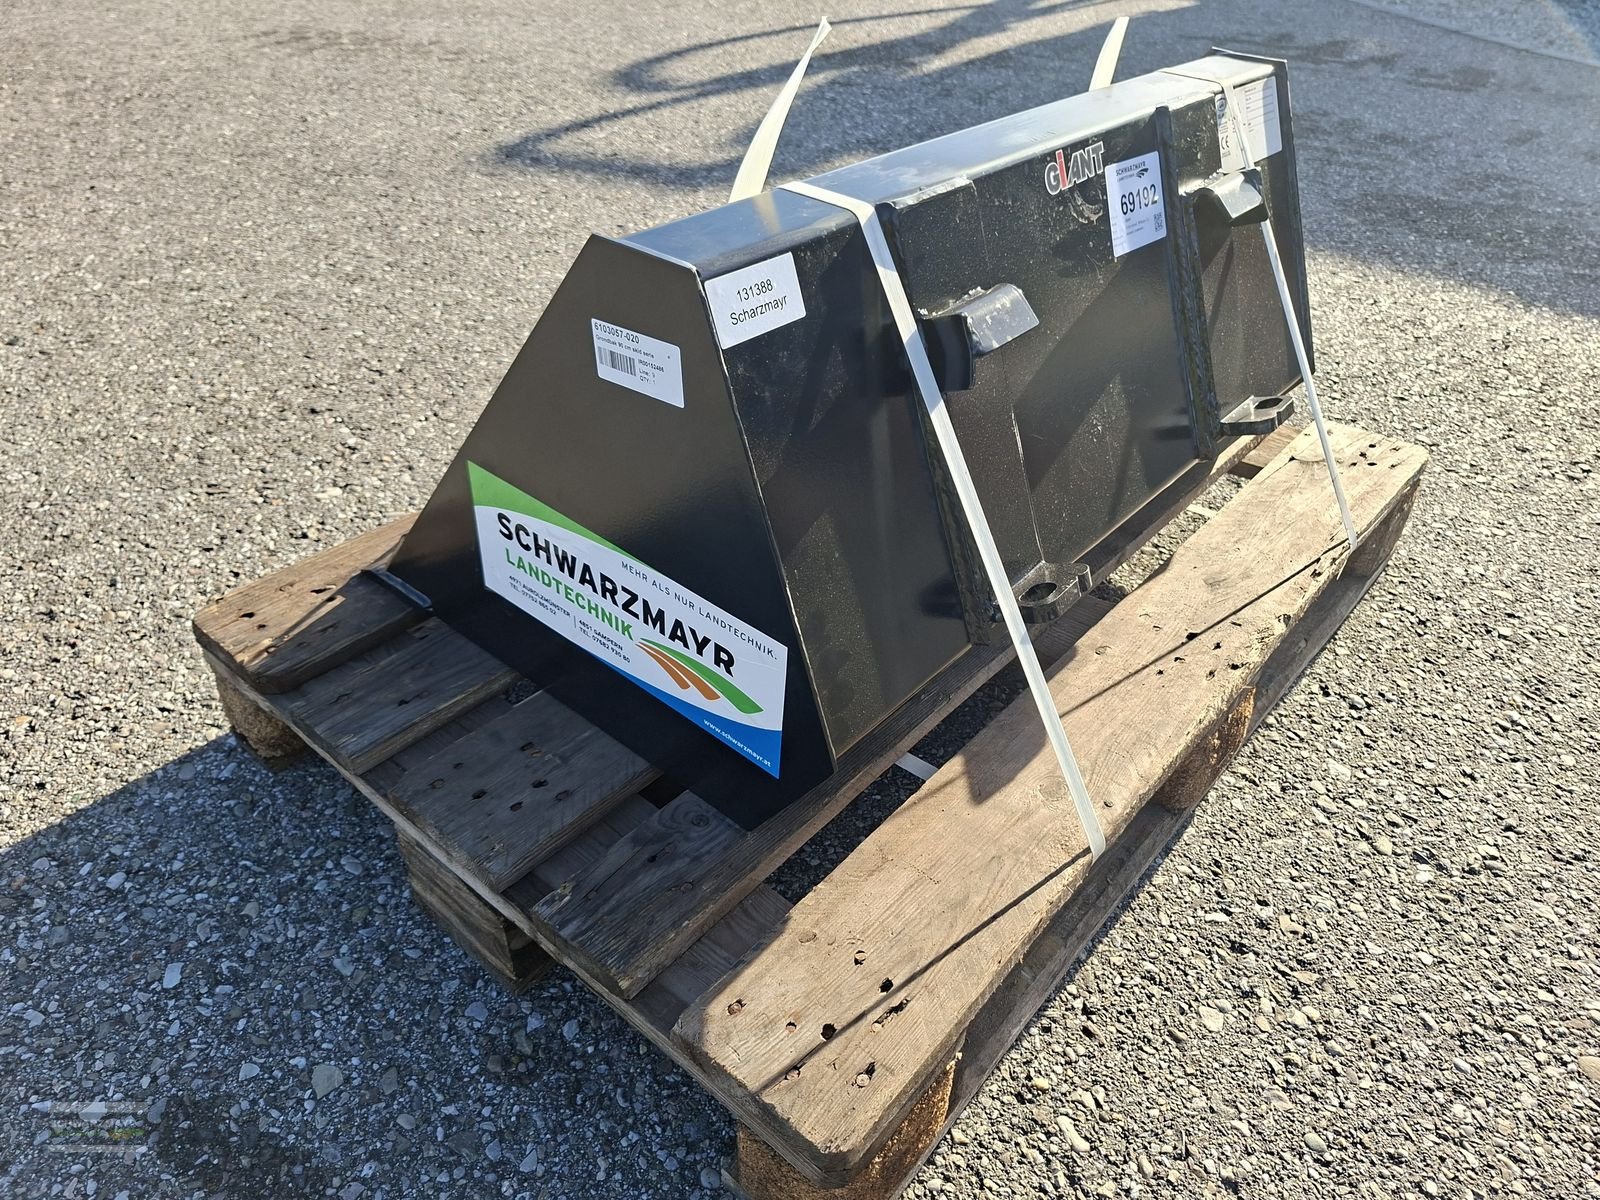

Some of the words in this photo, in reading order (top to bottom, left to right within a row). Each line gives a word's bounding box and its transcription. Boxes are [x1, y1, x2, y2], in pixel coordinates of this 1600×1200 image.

[1120, 184, 1158, 216] 69192
[736, 278, 774, 302] 131388
[730, 295, 788, 326] Scharzmayr
[594, 322, 640, 344] 6103057-020
[497, 512, 736, 677] SCHWARZMAYR
[505, 548, 634, 641] LANDTECHNIK
[523, 582, 570, 617] AUROLZMÜNSTER
[621, 560, 648, 582] MEHR
[652, 580, 670, 595] ALS
[674, 592, 695, 610] NUR
[699, 607, 778, 660] LANDTECHNIK.
[549, 607, 556, 616] 02
[578, 620, 593, 631] 4851
[594, 628, 623, 651] GAMPERN
[592, 635, 610, 650] 07682
[610, 647, 622, 658] 930
[623, 655, 631, 663] 80
[704, 719, 772, 768] www.schwarzmayr.at
